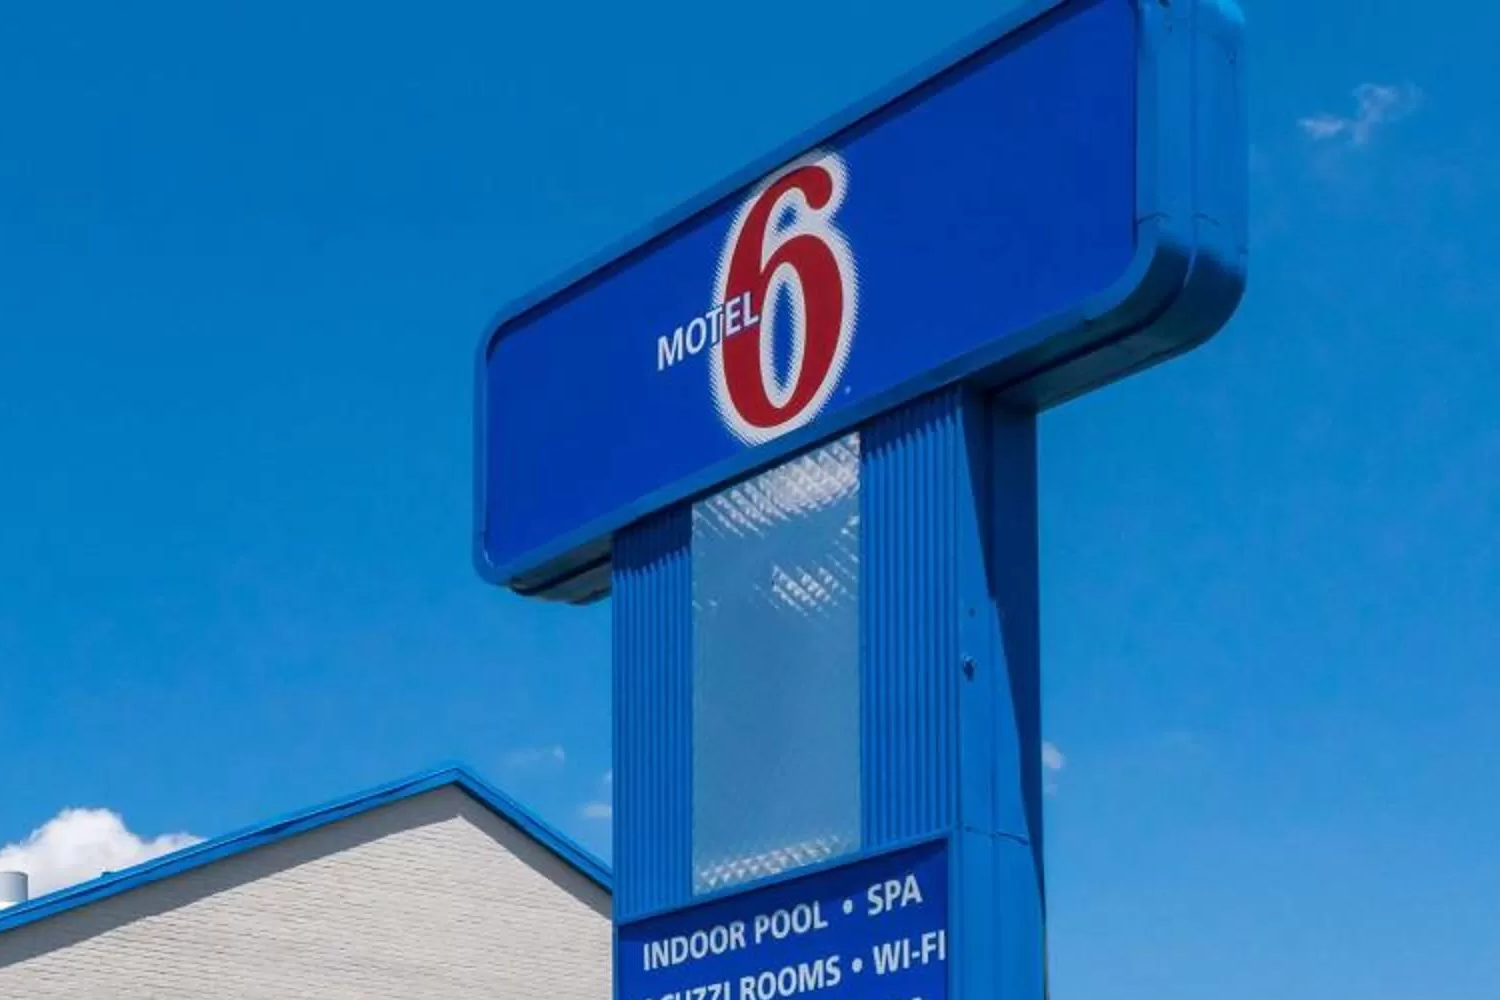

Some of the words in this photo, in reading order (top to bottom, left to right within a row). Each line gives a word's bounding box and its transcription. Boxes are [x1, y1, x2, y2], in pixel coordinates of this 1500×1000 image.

[657, 291, 760, 372] MOTEL
[719, 161, 847, 431] 6
[643, 921, 746, 971] INDOOR
[754, 901, 828, 944] POOL
[866, 874, 923, 916] SPA
[873, 930, 946, 975] WI-FI
